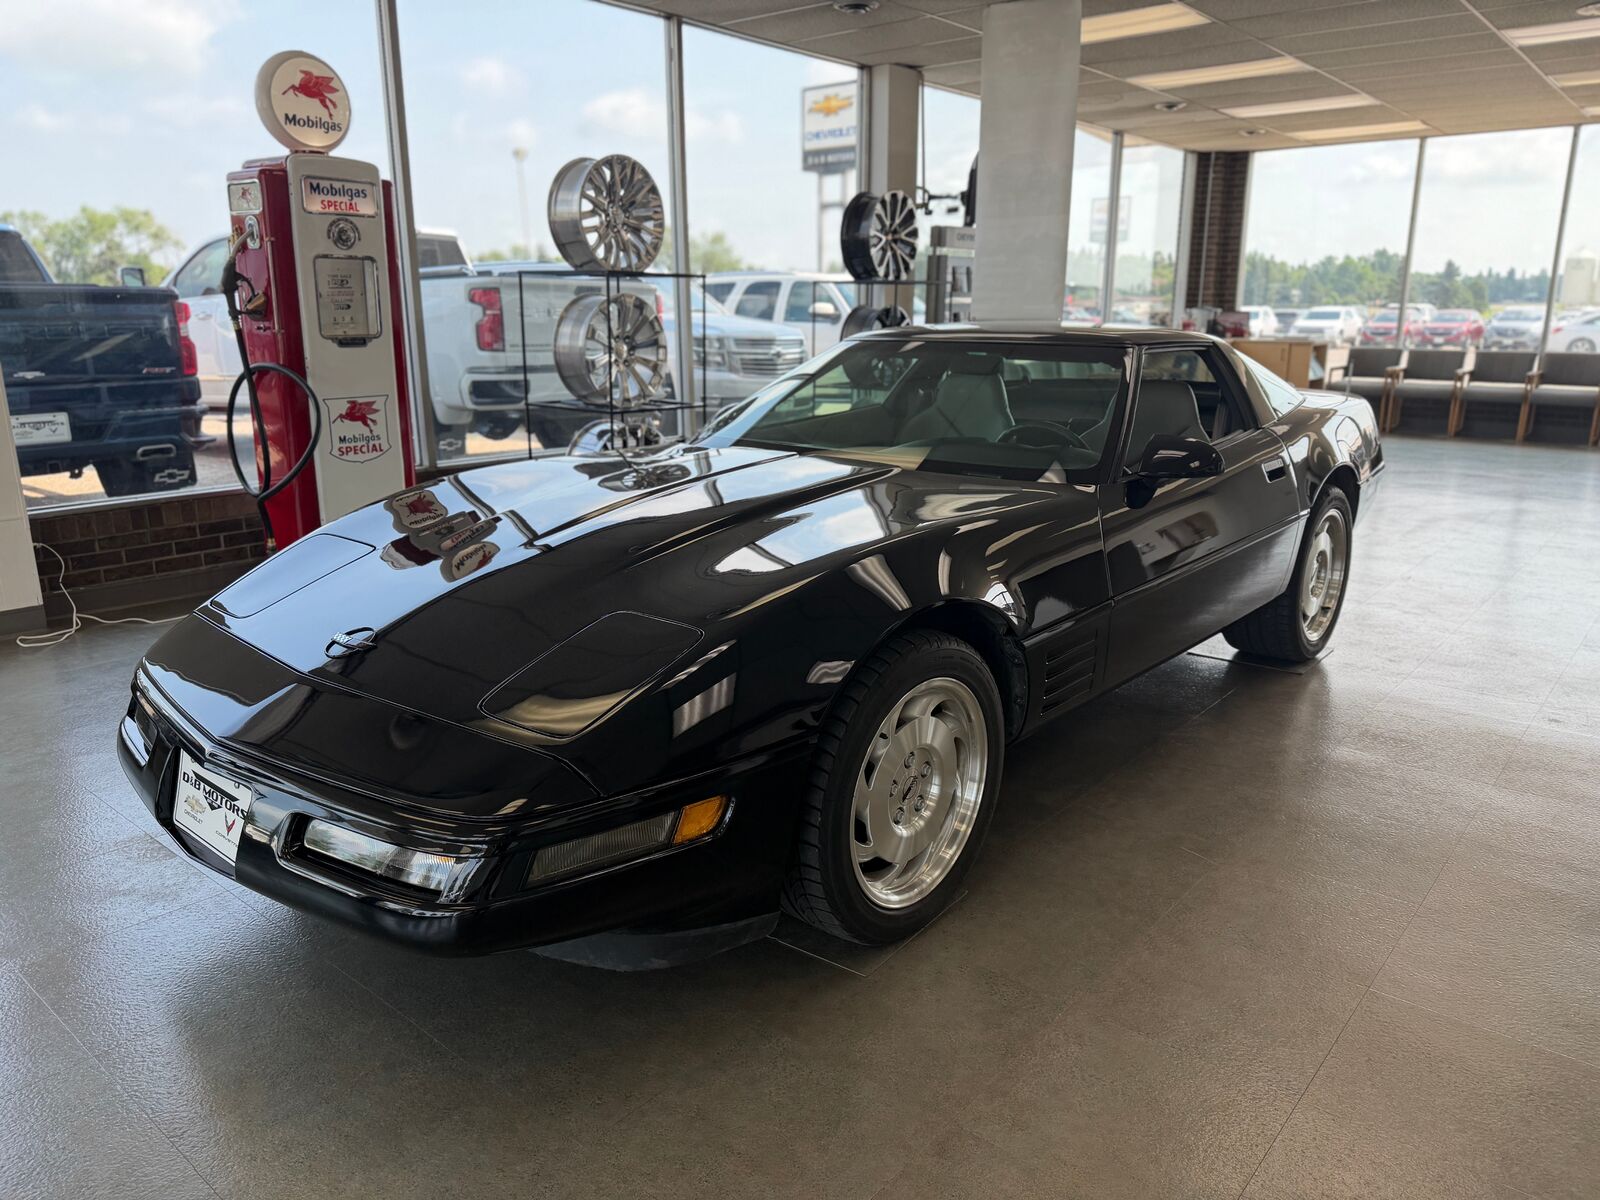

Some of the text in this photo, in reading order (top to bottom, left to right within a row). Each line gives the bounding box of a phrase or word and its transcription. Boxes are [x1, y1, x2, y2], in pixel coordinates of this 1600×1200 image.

[284, 113, 342, 134] Mobilgas
[309, 182, 368, 201] Mobilgas
[320, 199, 360, 212] SPECIAL
[338, 433, 381, 445] Mobilgas
[337, 443, 384, 457] SPECIAL
[182, 771, 201, 791] D&B
[202, 785, 248, 820] MOTORS
